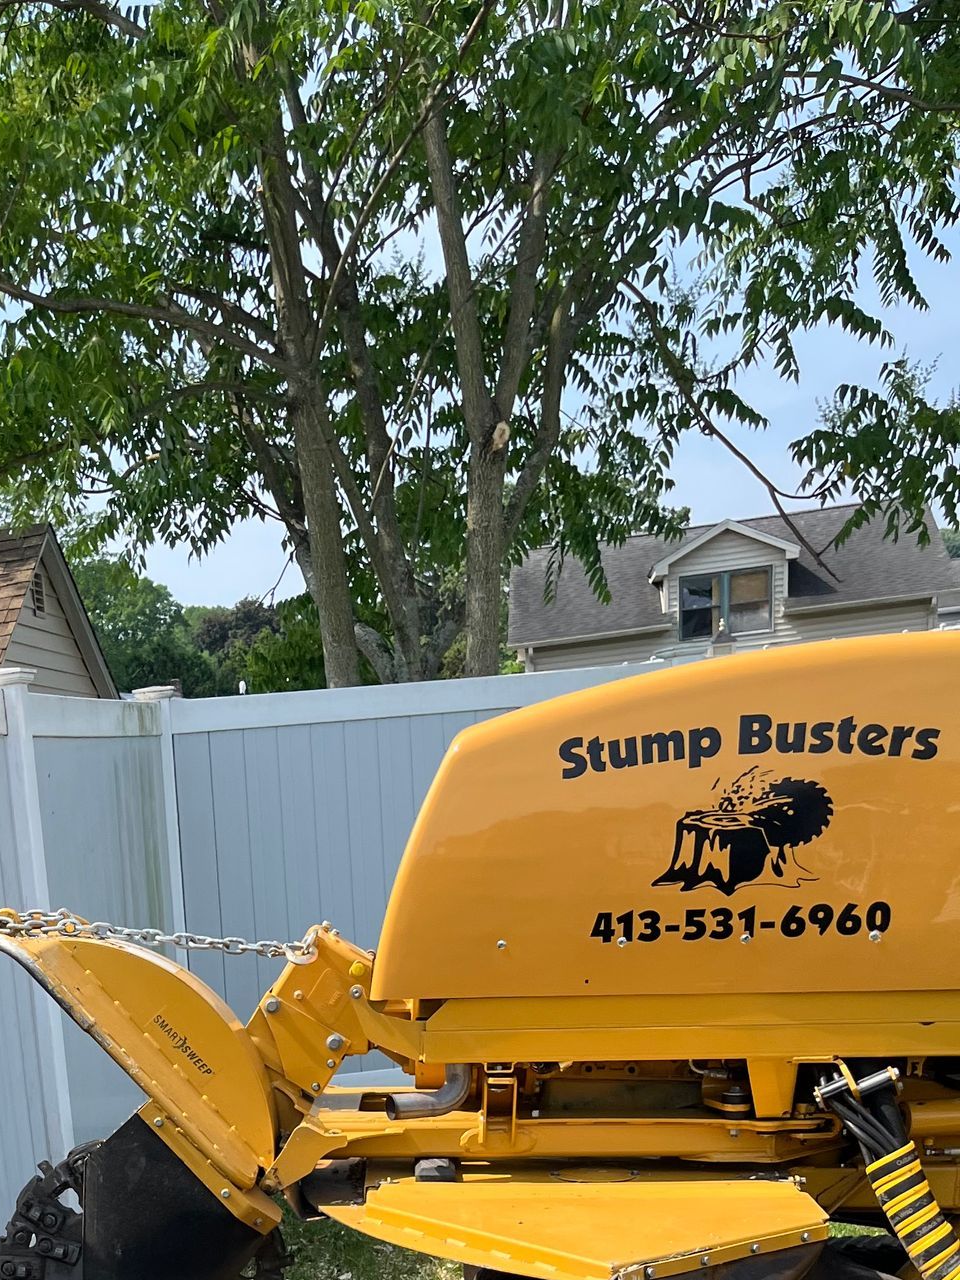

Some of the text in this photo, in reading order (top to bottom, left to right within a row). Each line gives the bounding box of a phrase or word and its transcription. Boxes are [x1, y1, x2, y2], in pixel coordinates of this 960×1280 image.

[558, 713, 941, 780] Stump Busters
[589, 900, 892, 944] 413-531-6960
[152, 1014, 213, 1075] SMART SWEEP
